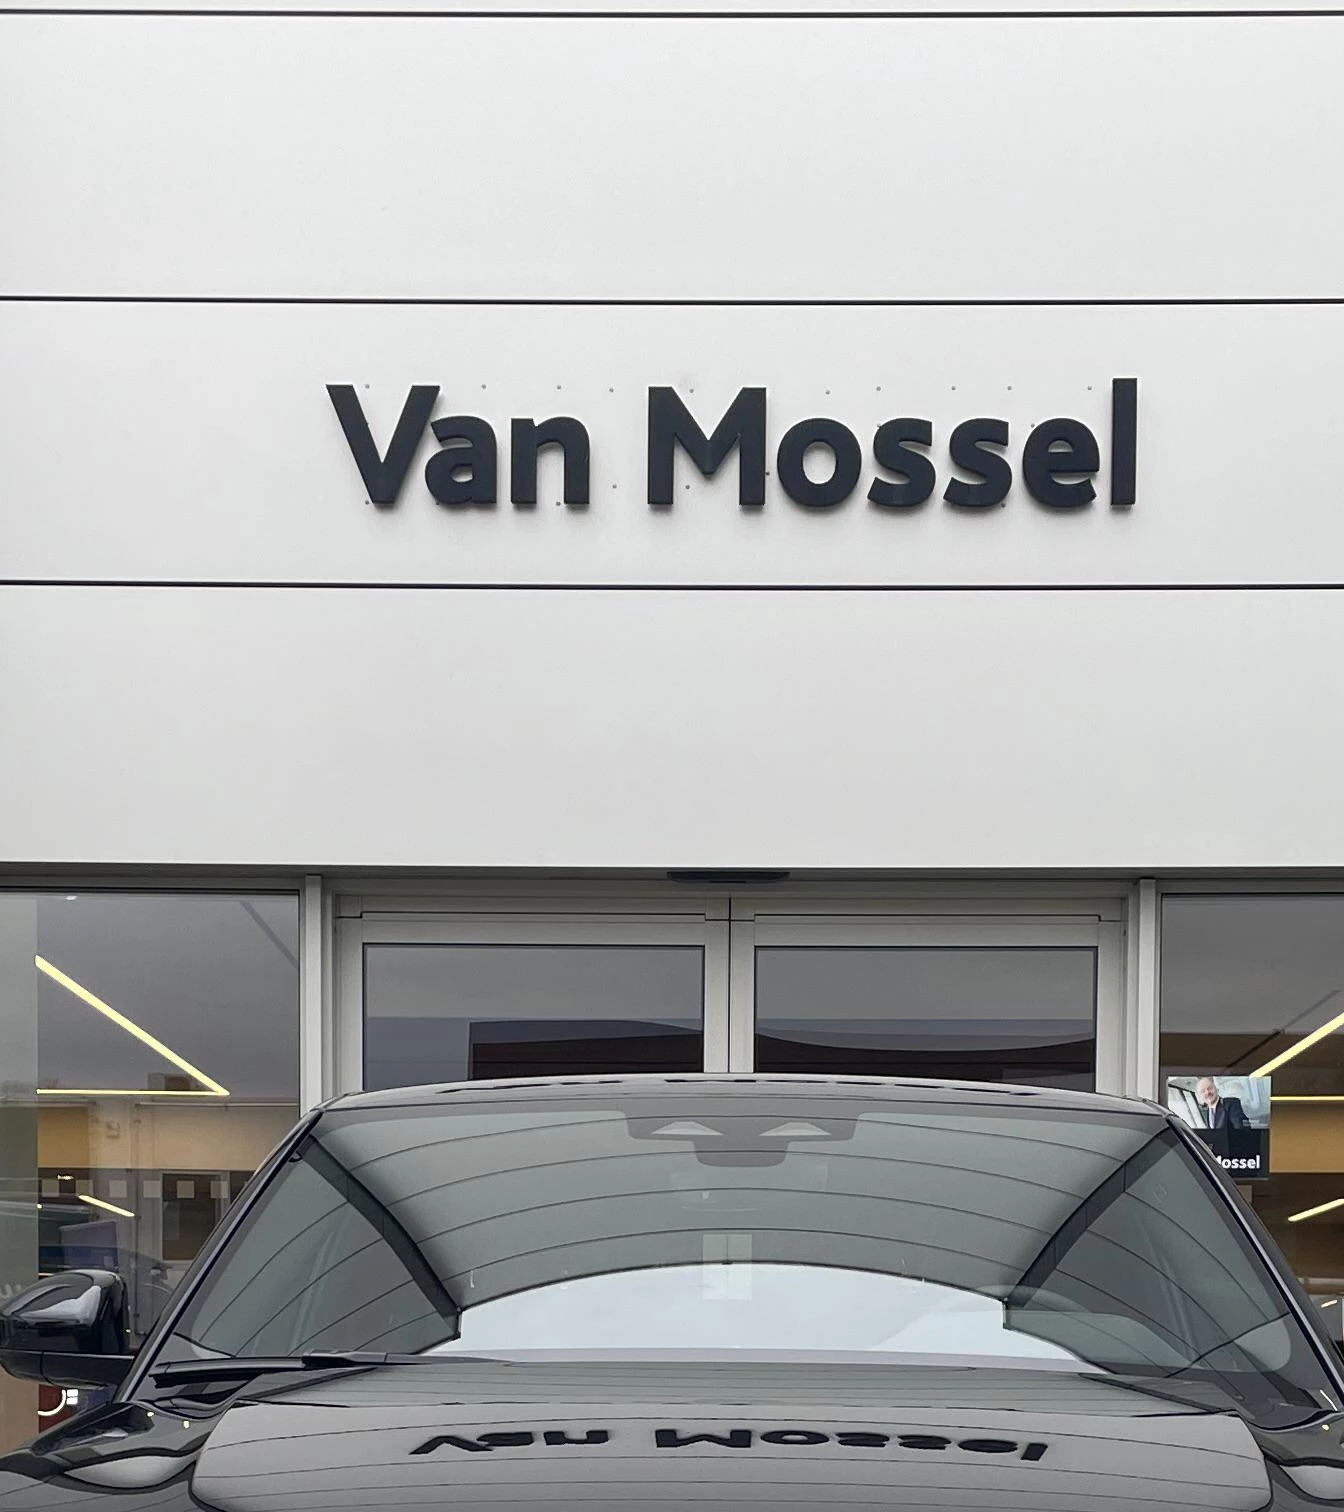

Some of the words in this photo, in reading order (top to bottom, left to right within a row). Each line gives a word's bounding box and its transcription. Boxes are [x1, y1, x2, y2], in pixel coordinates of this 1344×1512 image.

[325, 383, 591, 506] Van
[648, 377, 1138, 508] Mossel
[1215, 1154, 1261, 1169] ossel
